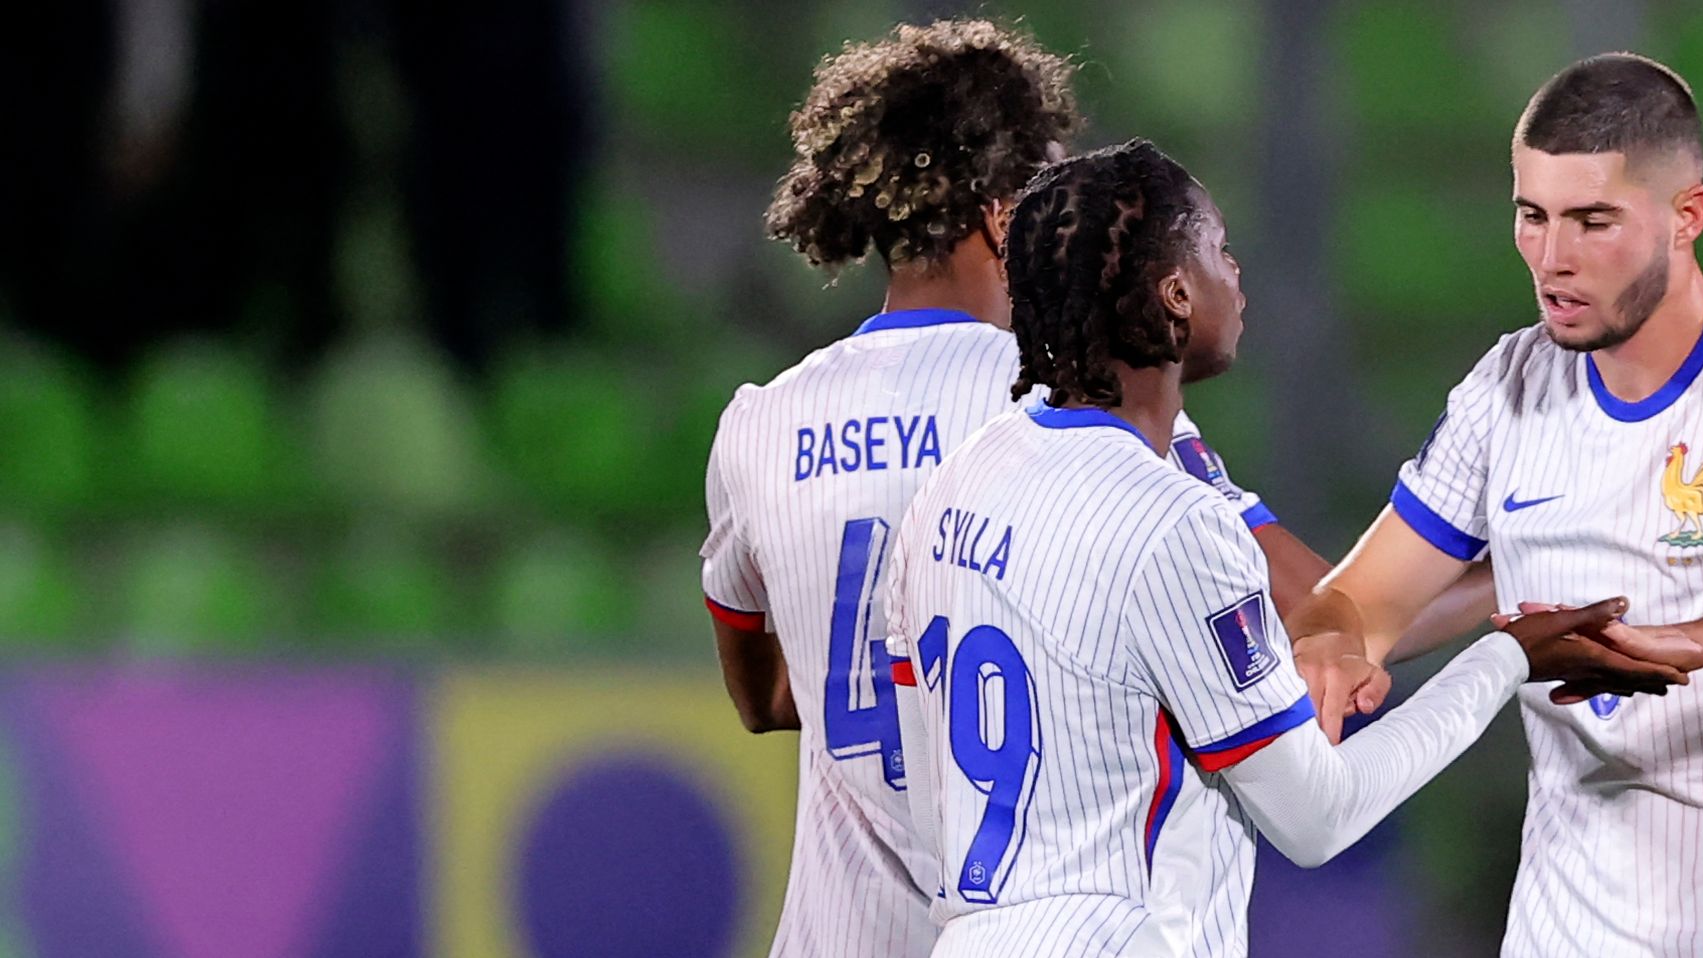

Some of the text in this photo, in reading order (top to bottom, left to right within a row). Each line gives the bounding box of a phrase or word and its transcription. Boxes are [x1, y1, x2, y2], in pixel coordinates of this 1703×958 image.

[794, 415, 943, 482] BASEYA
[932, 507, 1013, 581] SYLLA
[824, 516, 907, 792] 4
[917, 614, 1042, 904] 19
